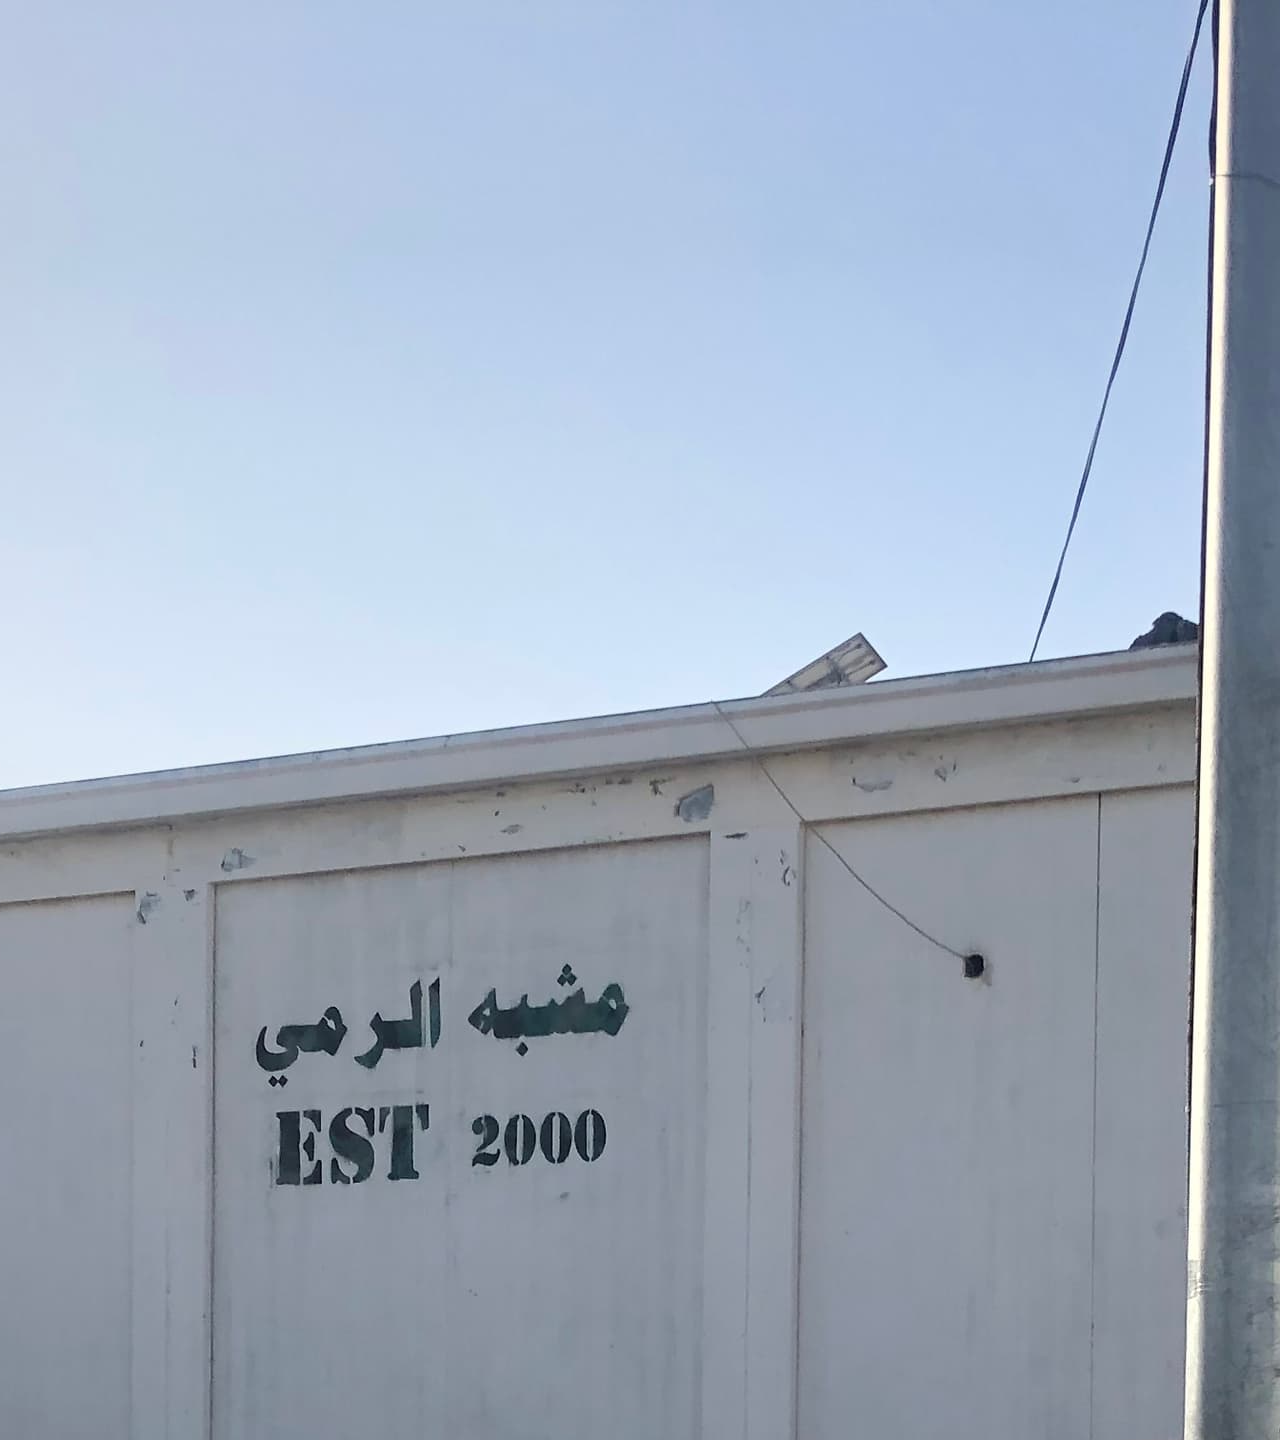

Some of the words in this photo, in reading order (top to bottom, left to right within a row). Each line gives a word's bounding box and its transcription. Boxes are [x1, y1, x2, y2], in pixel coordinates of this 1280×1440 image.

[255, 976, 441, 1088] الرمي
[275, 1103, 430, 1186] EST
[471, 1108, 608, 1168] 2000
